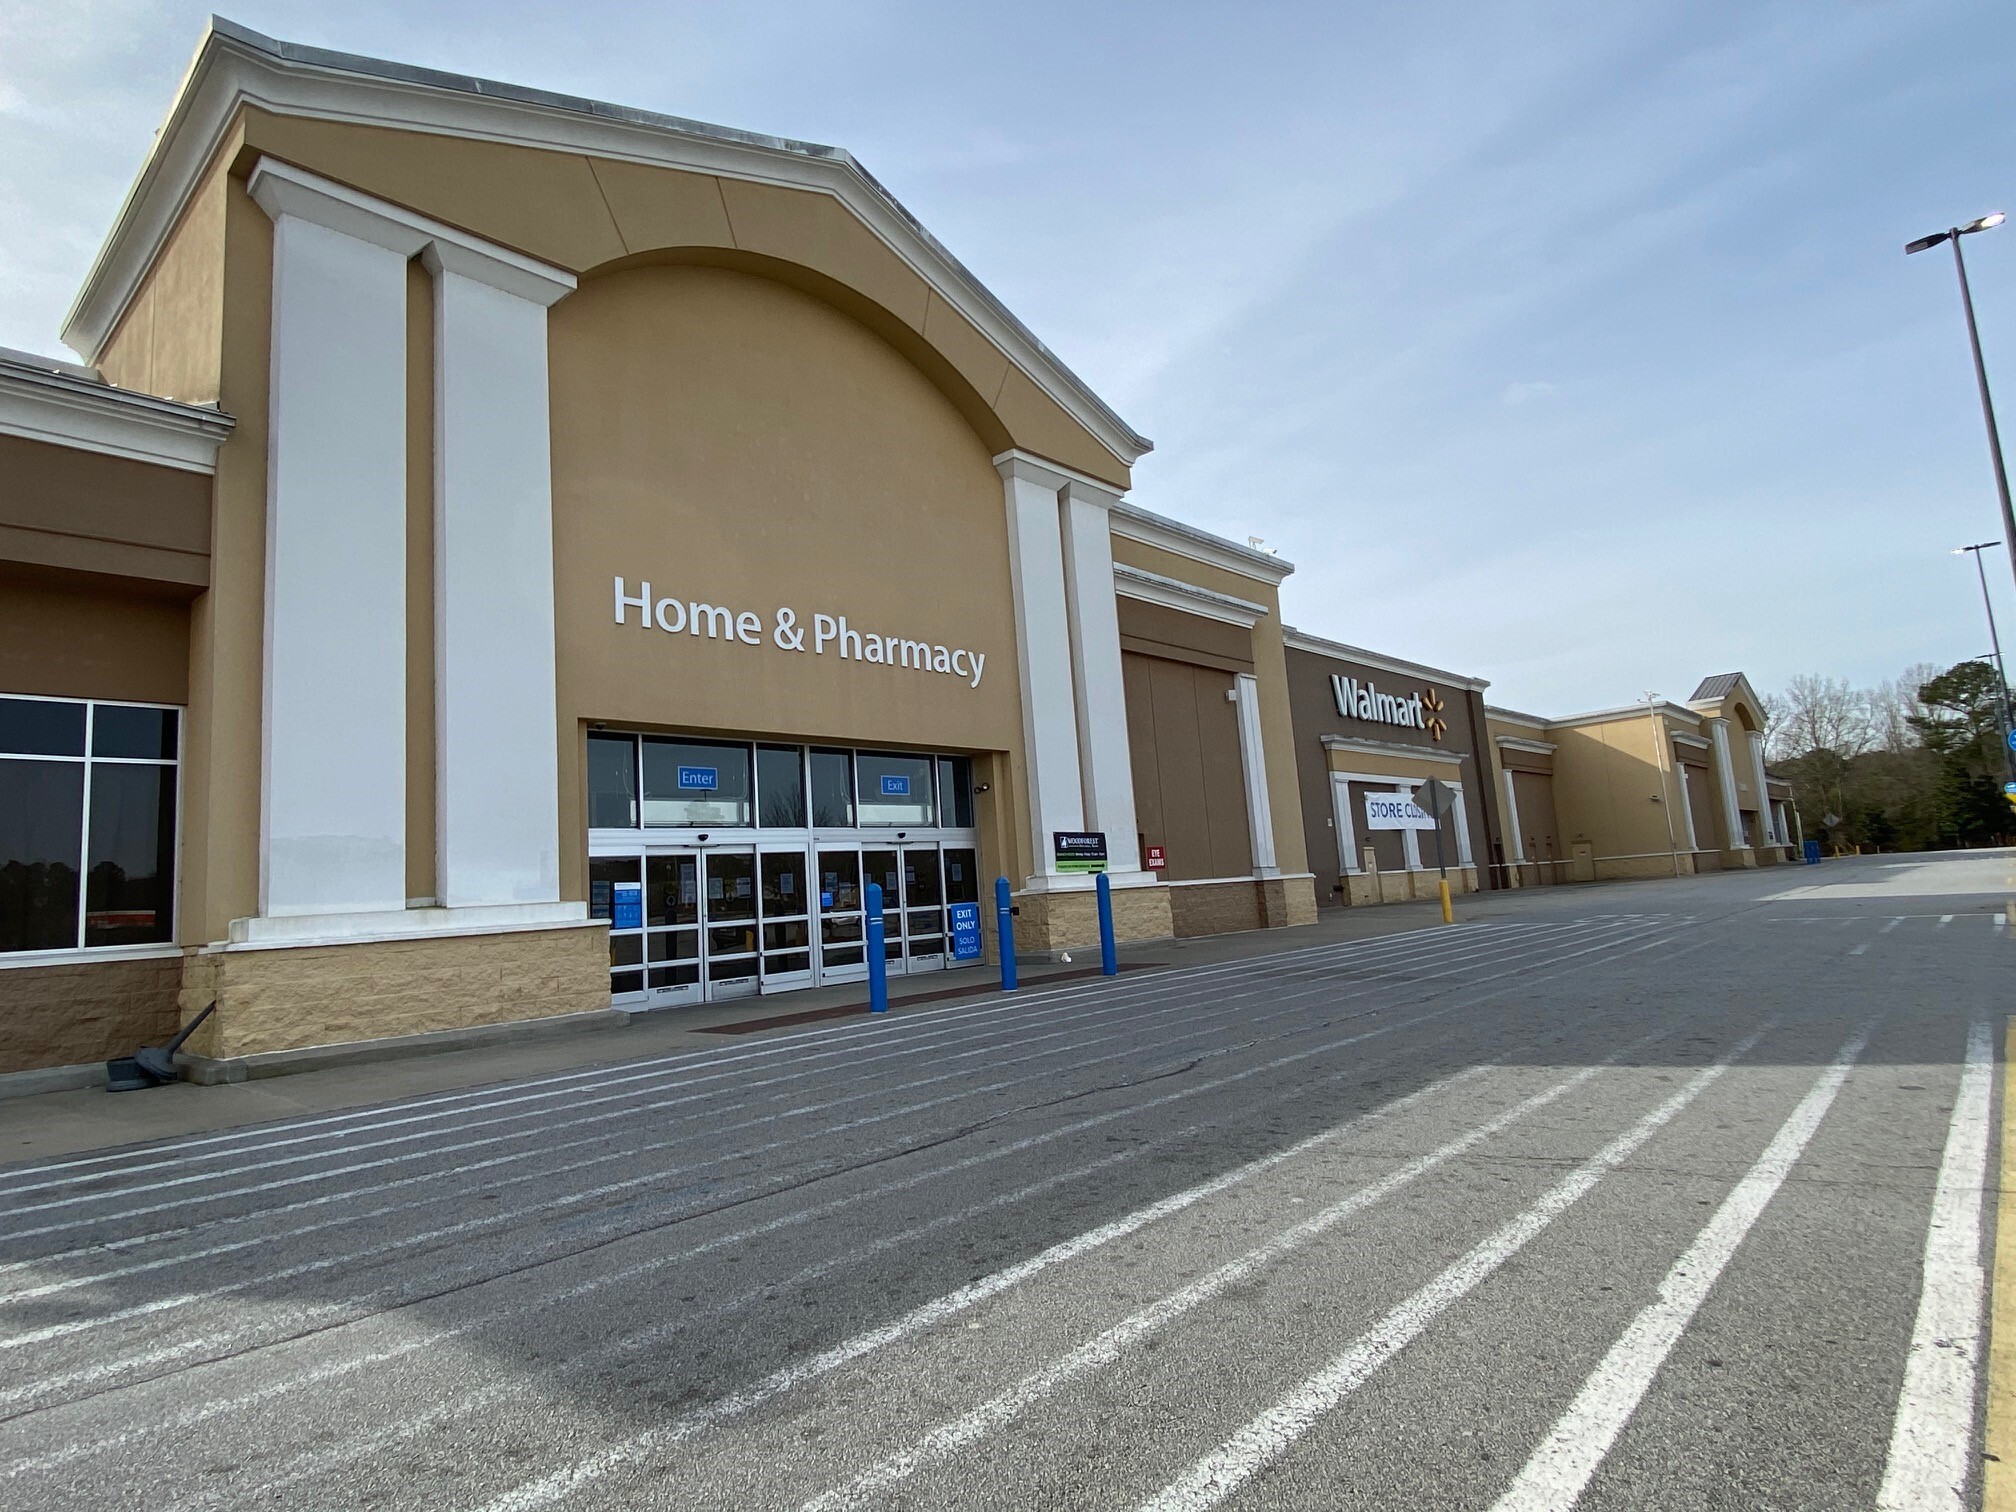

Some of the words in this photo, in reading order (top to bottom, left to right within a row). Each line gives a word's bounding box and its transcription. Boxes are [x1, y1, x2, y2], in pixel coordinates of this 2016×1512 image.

[614, 576, 762, 645] Home
[773, 607, 805, 652] &
[813, 613, 986, 688] Pharmacy
[1330, 674, 1425, 730] Walmart
[682, 771, 714, 785] Enter
[887, 779, 904, 791] Exit
[1370, 802, 1403, 819] STORE
[956, 909, 972, 919] EXIT
[956, 921, 976, 931] ONLY
[959, 936, 975, 945] SOLO
[957, 945, 978, 955] SALIDA
